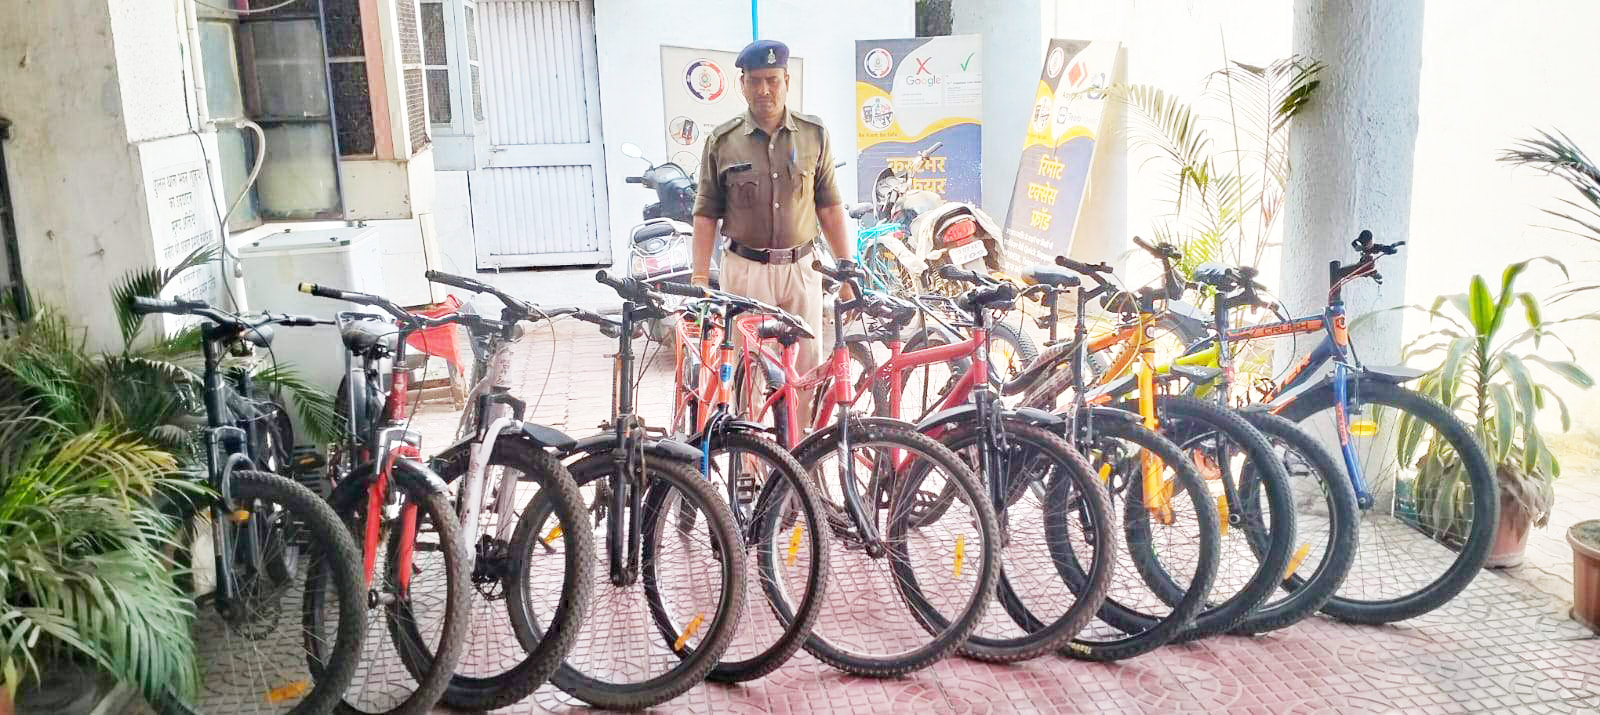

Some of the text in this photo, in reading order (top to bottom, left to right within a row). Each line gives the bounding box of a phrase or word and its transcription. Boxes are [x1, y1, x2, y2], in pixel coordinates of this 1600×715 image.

[906, 75, 941, 88] Google
[1038, 153, 1067, 180] रिमोट
[1027, 181, 1058, 206] एक्सेस
[1030, 206, 1053, 231] फ्रॉड
